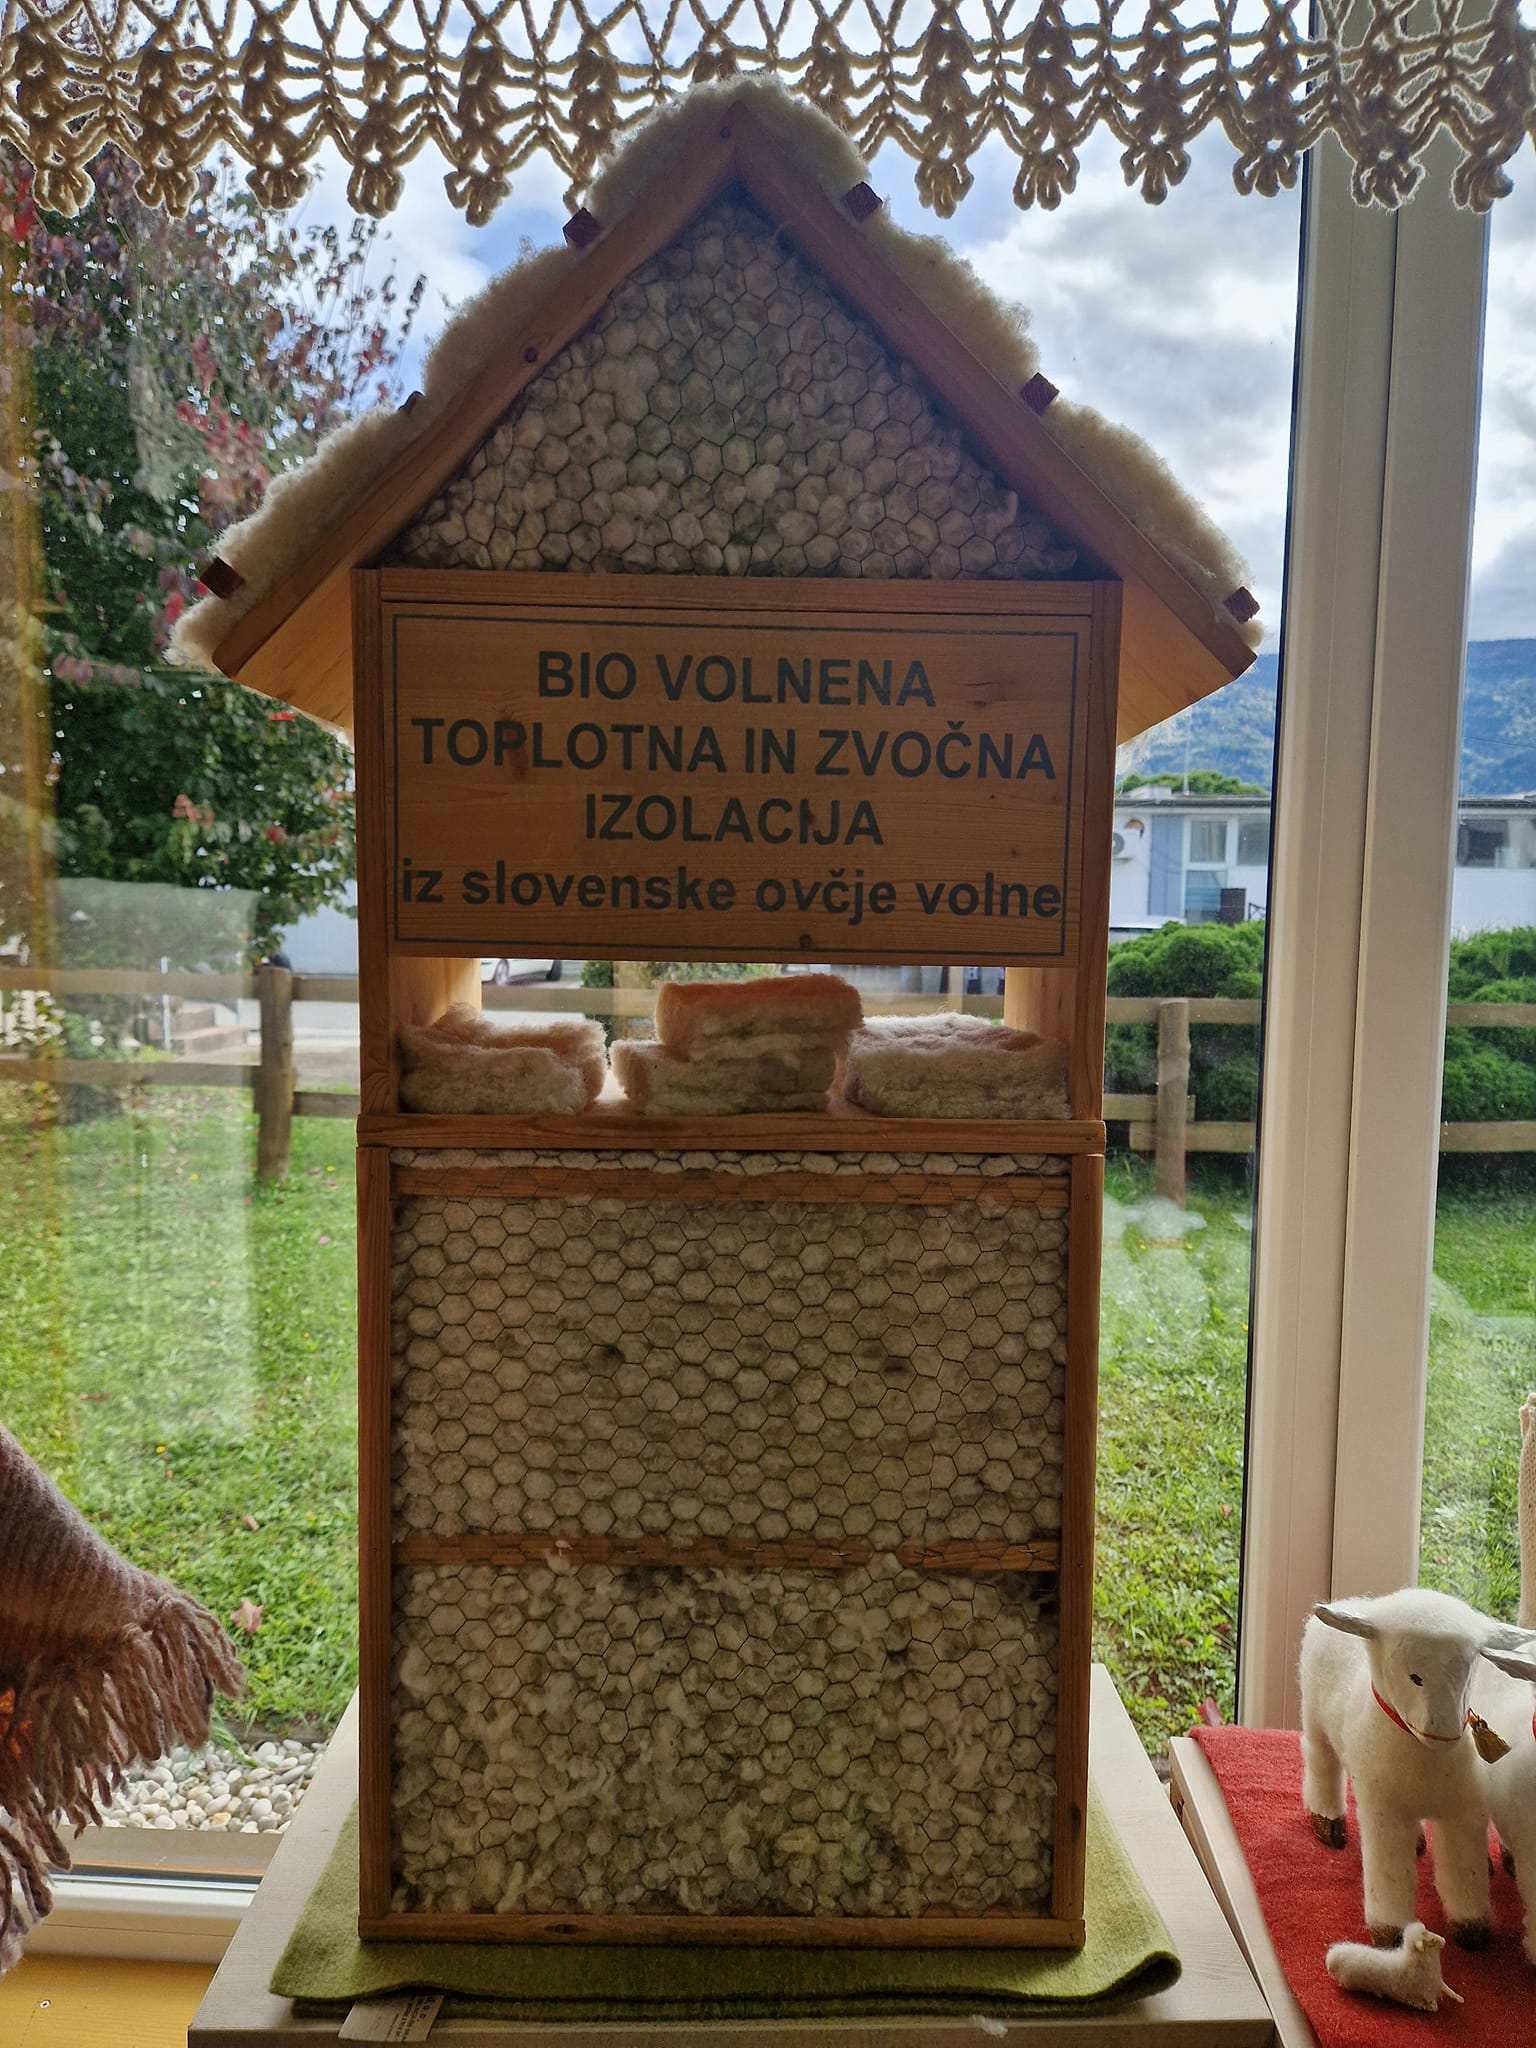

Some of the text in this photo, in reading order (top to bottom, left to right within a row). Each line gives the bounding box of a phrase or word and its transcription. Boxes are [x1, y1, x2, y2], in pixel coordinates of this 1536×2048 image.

[538, 650, 936, 707] BIO VOLNENA
[411, 717, 1056, 780] TOPLOTNA IN ZVOČNA
[585, 793, 884, 846] IZOLACIJA
[402, 857, 1062, 926] iz slovenske ovčje volne
